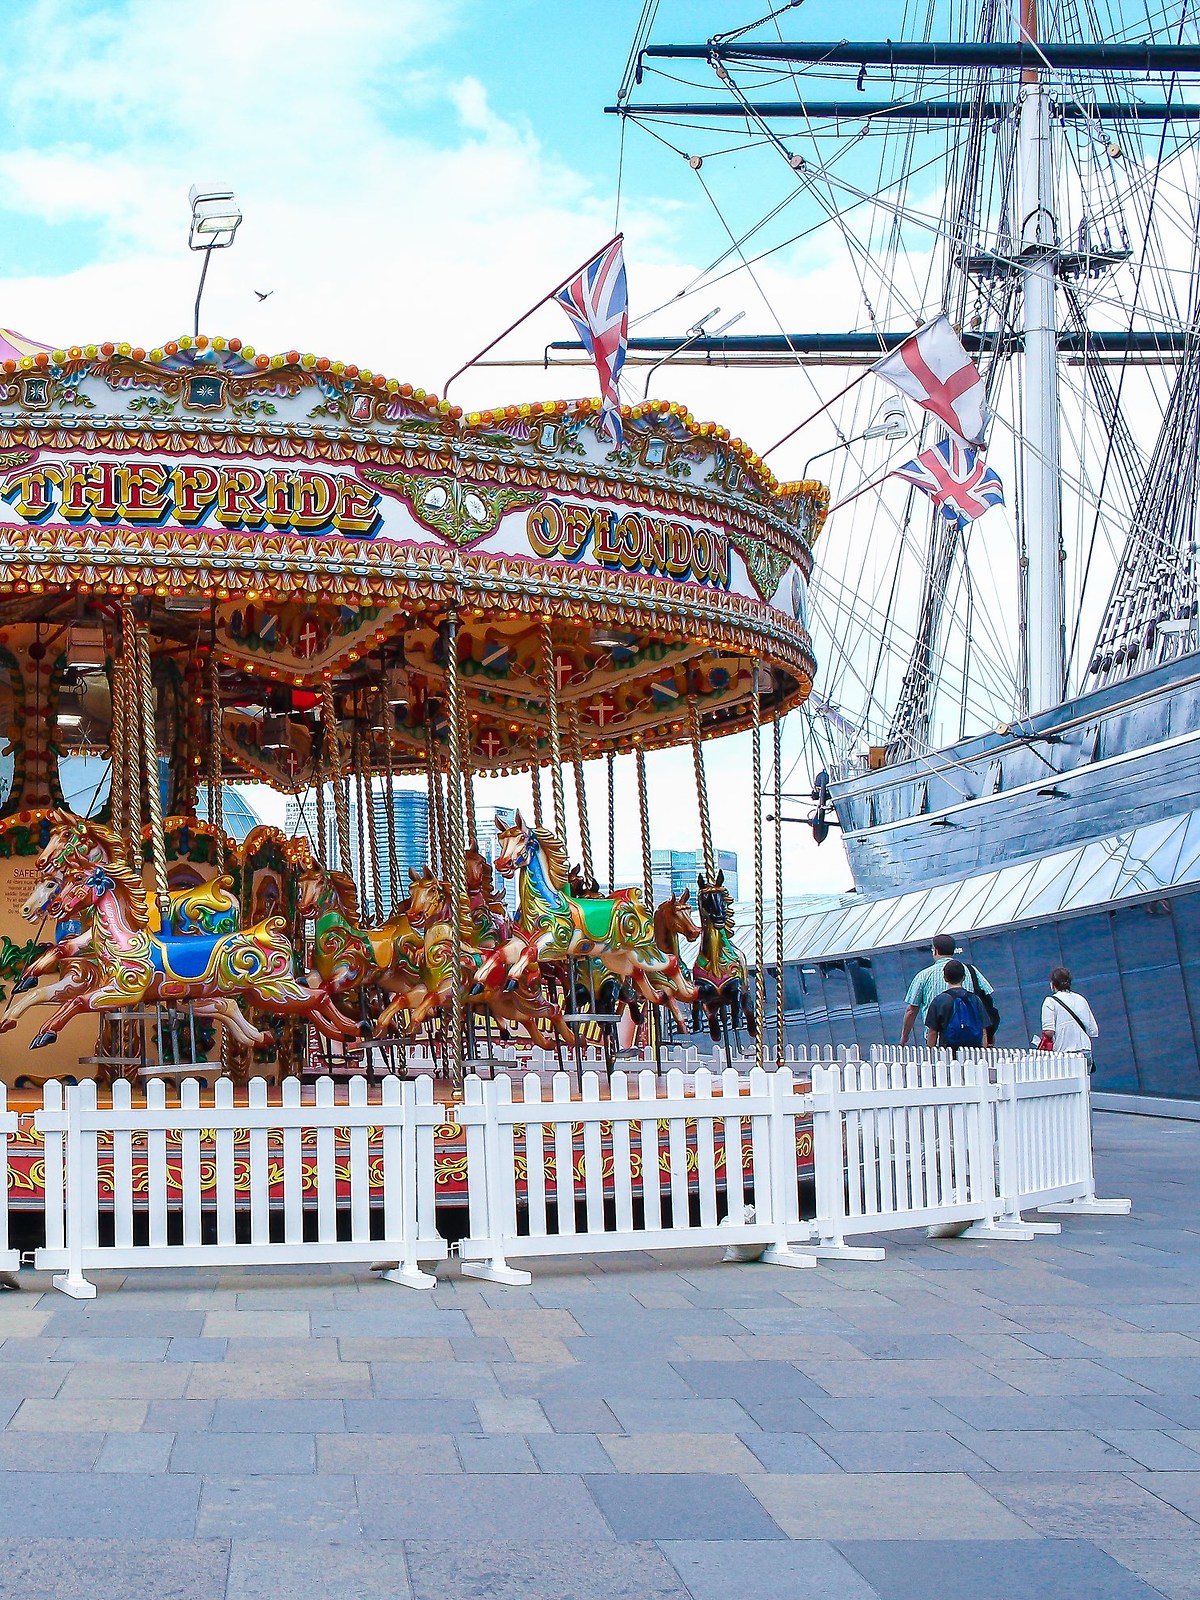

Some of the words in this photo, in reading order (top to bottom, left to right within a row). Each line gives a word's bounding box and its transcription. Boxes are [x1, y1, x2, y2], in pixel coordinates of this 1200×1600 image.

[0, 458, 173, 527] THE
[172, 463, 385, 540] PRIDE
[526, 498, 595, 564] OF
[592, 506, 734, 592] LONDON
[13, 868, 41, 878] SAFET
